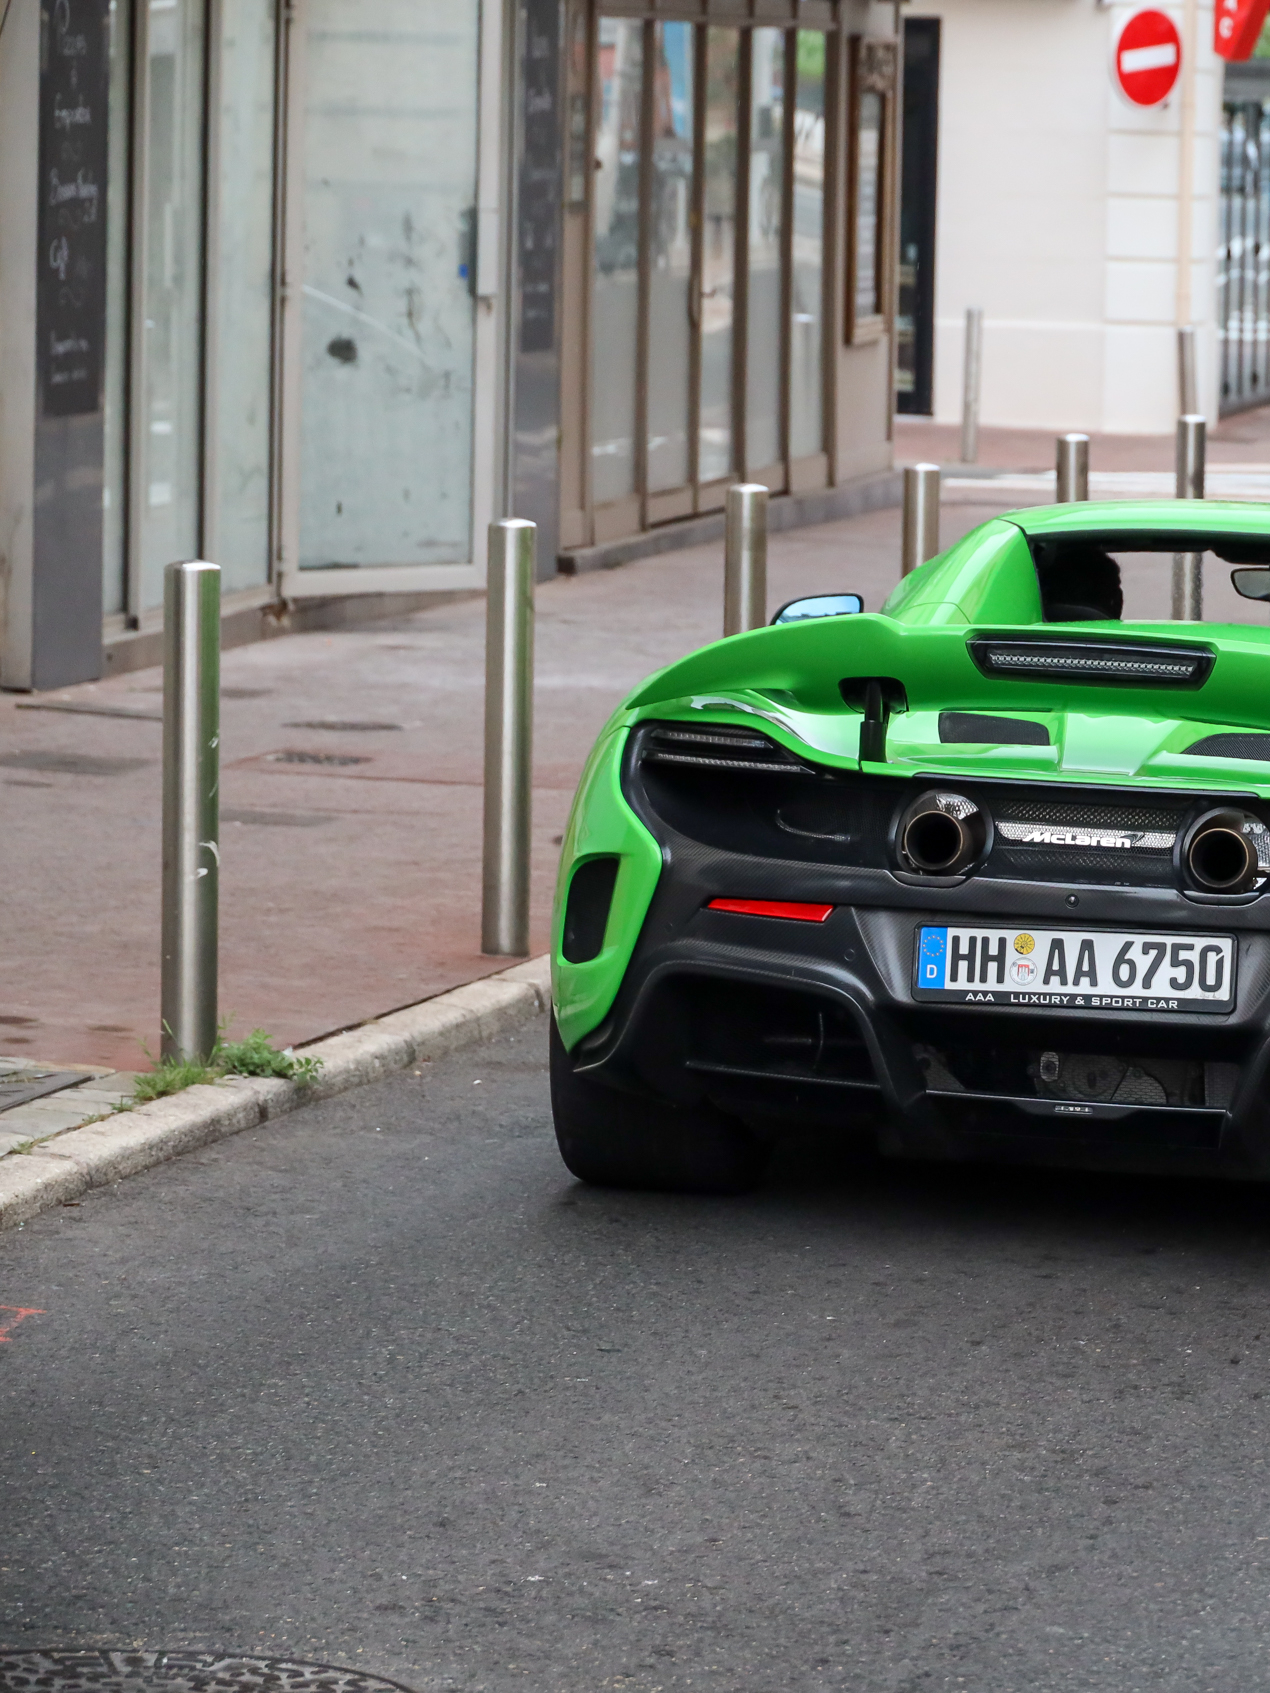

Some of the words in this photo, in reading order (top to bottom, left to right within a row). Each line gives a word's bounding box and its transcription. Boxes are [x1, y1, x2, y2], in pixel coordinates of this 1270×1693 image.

[1022, 831, 1132, 848] McLaren
[926, 964, 938, 979] D
[950, 935, 1007, 984] HH
[1042, 937, 1098, 987] AA
[1111, 940, 1225, 993] 6750
[965, 992, 995, 1002] AAA
[1010, 993, 1070, 1005] LUXURY
[1075, 996, 1086, 1005] &
[1091, 997, 1142, 1007] SPORT
[1147, 999, 1178, 1009] CAR
